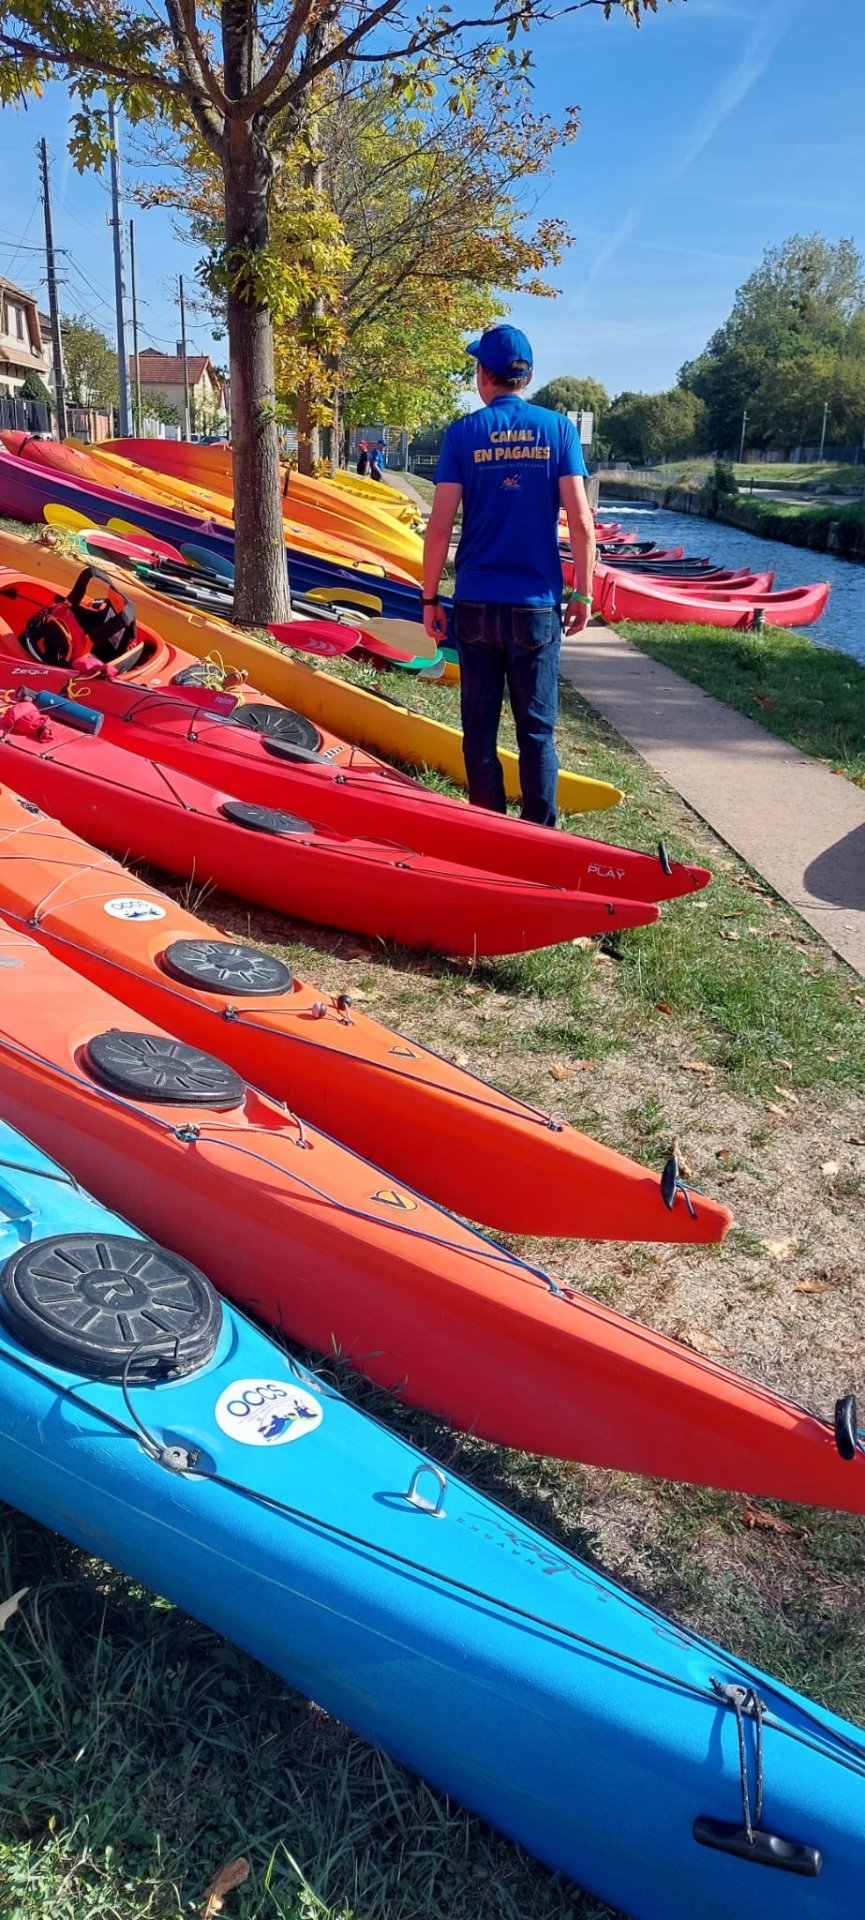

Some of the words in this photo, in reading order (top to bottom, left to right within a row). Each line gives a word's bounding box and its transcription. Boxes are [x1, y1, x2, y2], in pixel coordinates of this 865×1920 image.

[490, 430, 535, 443] CANAL
[473, 449, 492, 463] EN
[495, 446, 551, 460] PAGAIES
[587, 865, 625, 879] PLAY
[227, 1384, 287, 1417] OCCS
